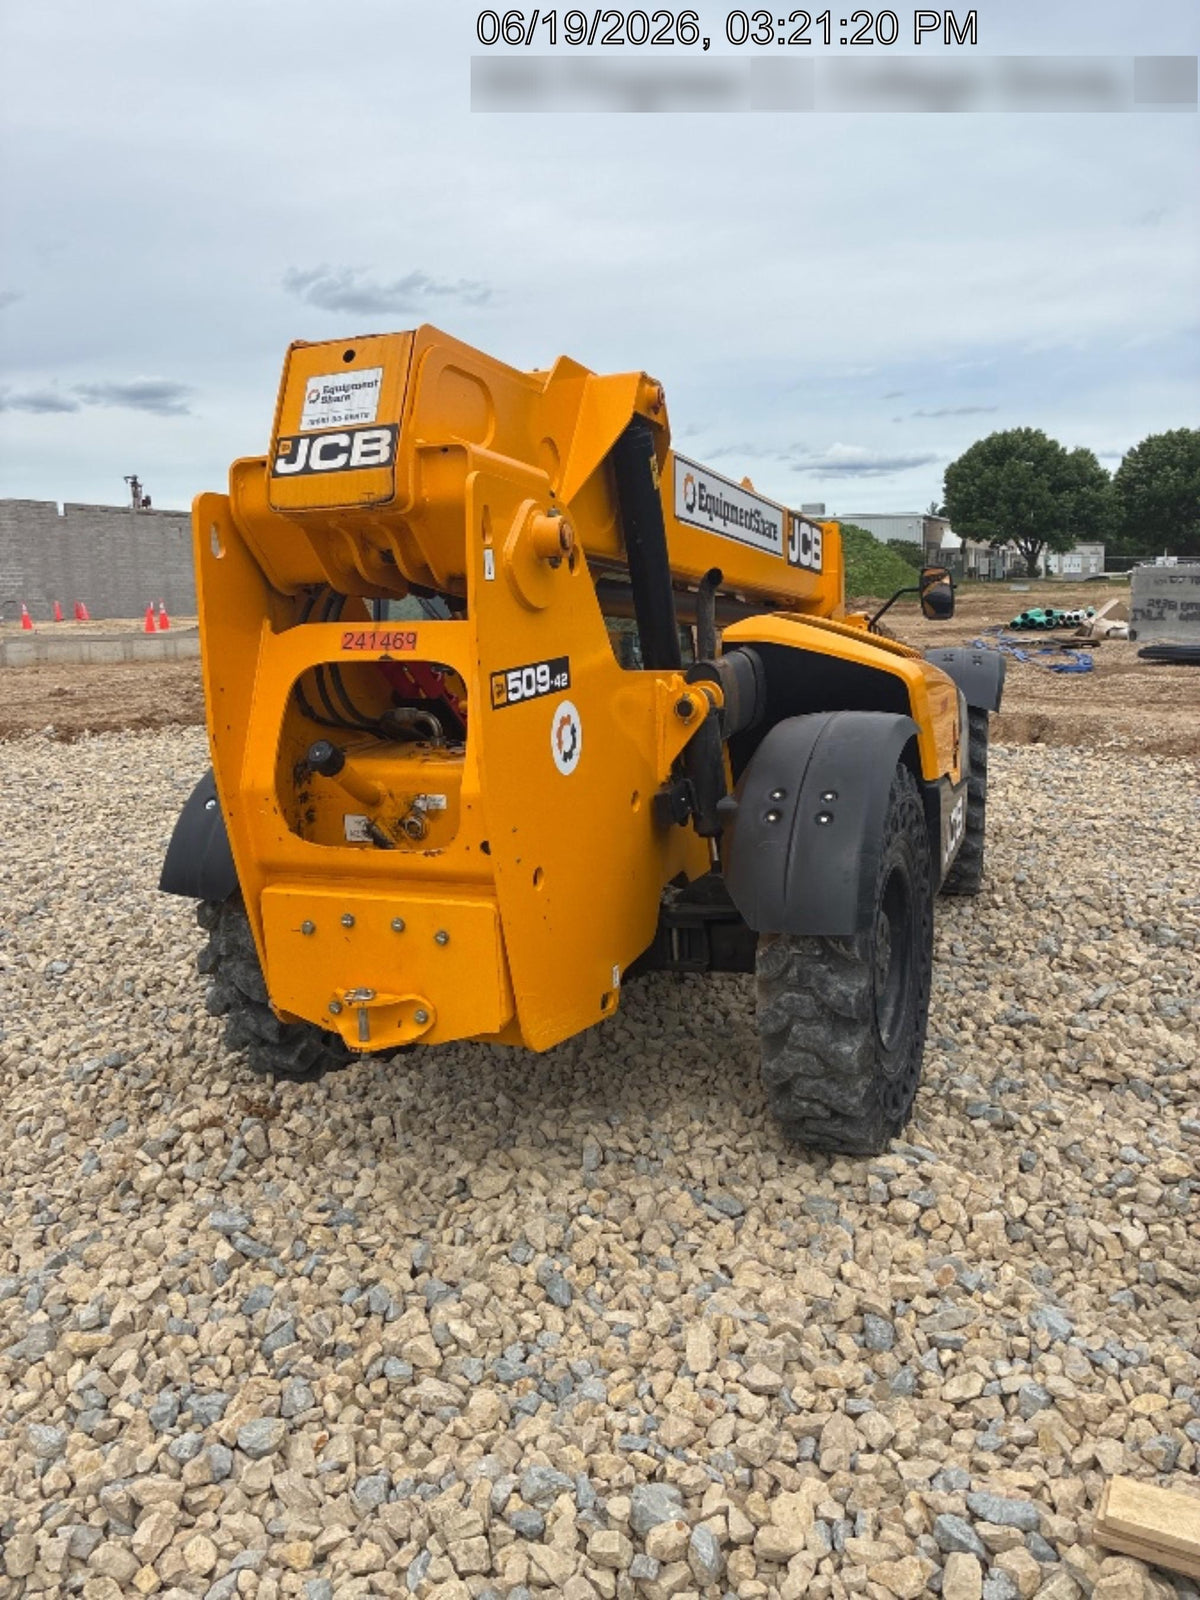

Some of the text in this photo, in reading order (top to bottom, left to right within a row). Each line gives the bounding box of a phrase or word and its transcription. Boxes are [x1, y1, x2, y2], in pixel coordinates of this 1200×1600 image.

[275, 429, 392, 474] JCB
[698, 481, 778, 541] EquipmentShare
[788, 517, 822, 571] JCB
[342, 631, 417, 650] 241469
